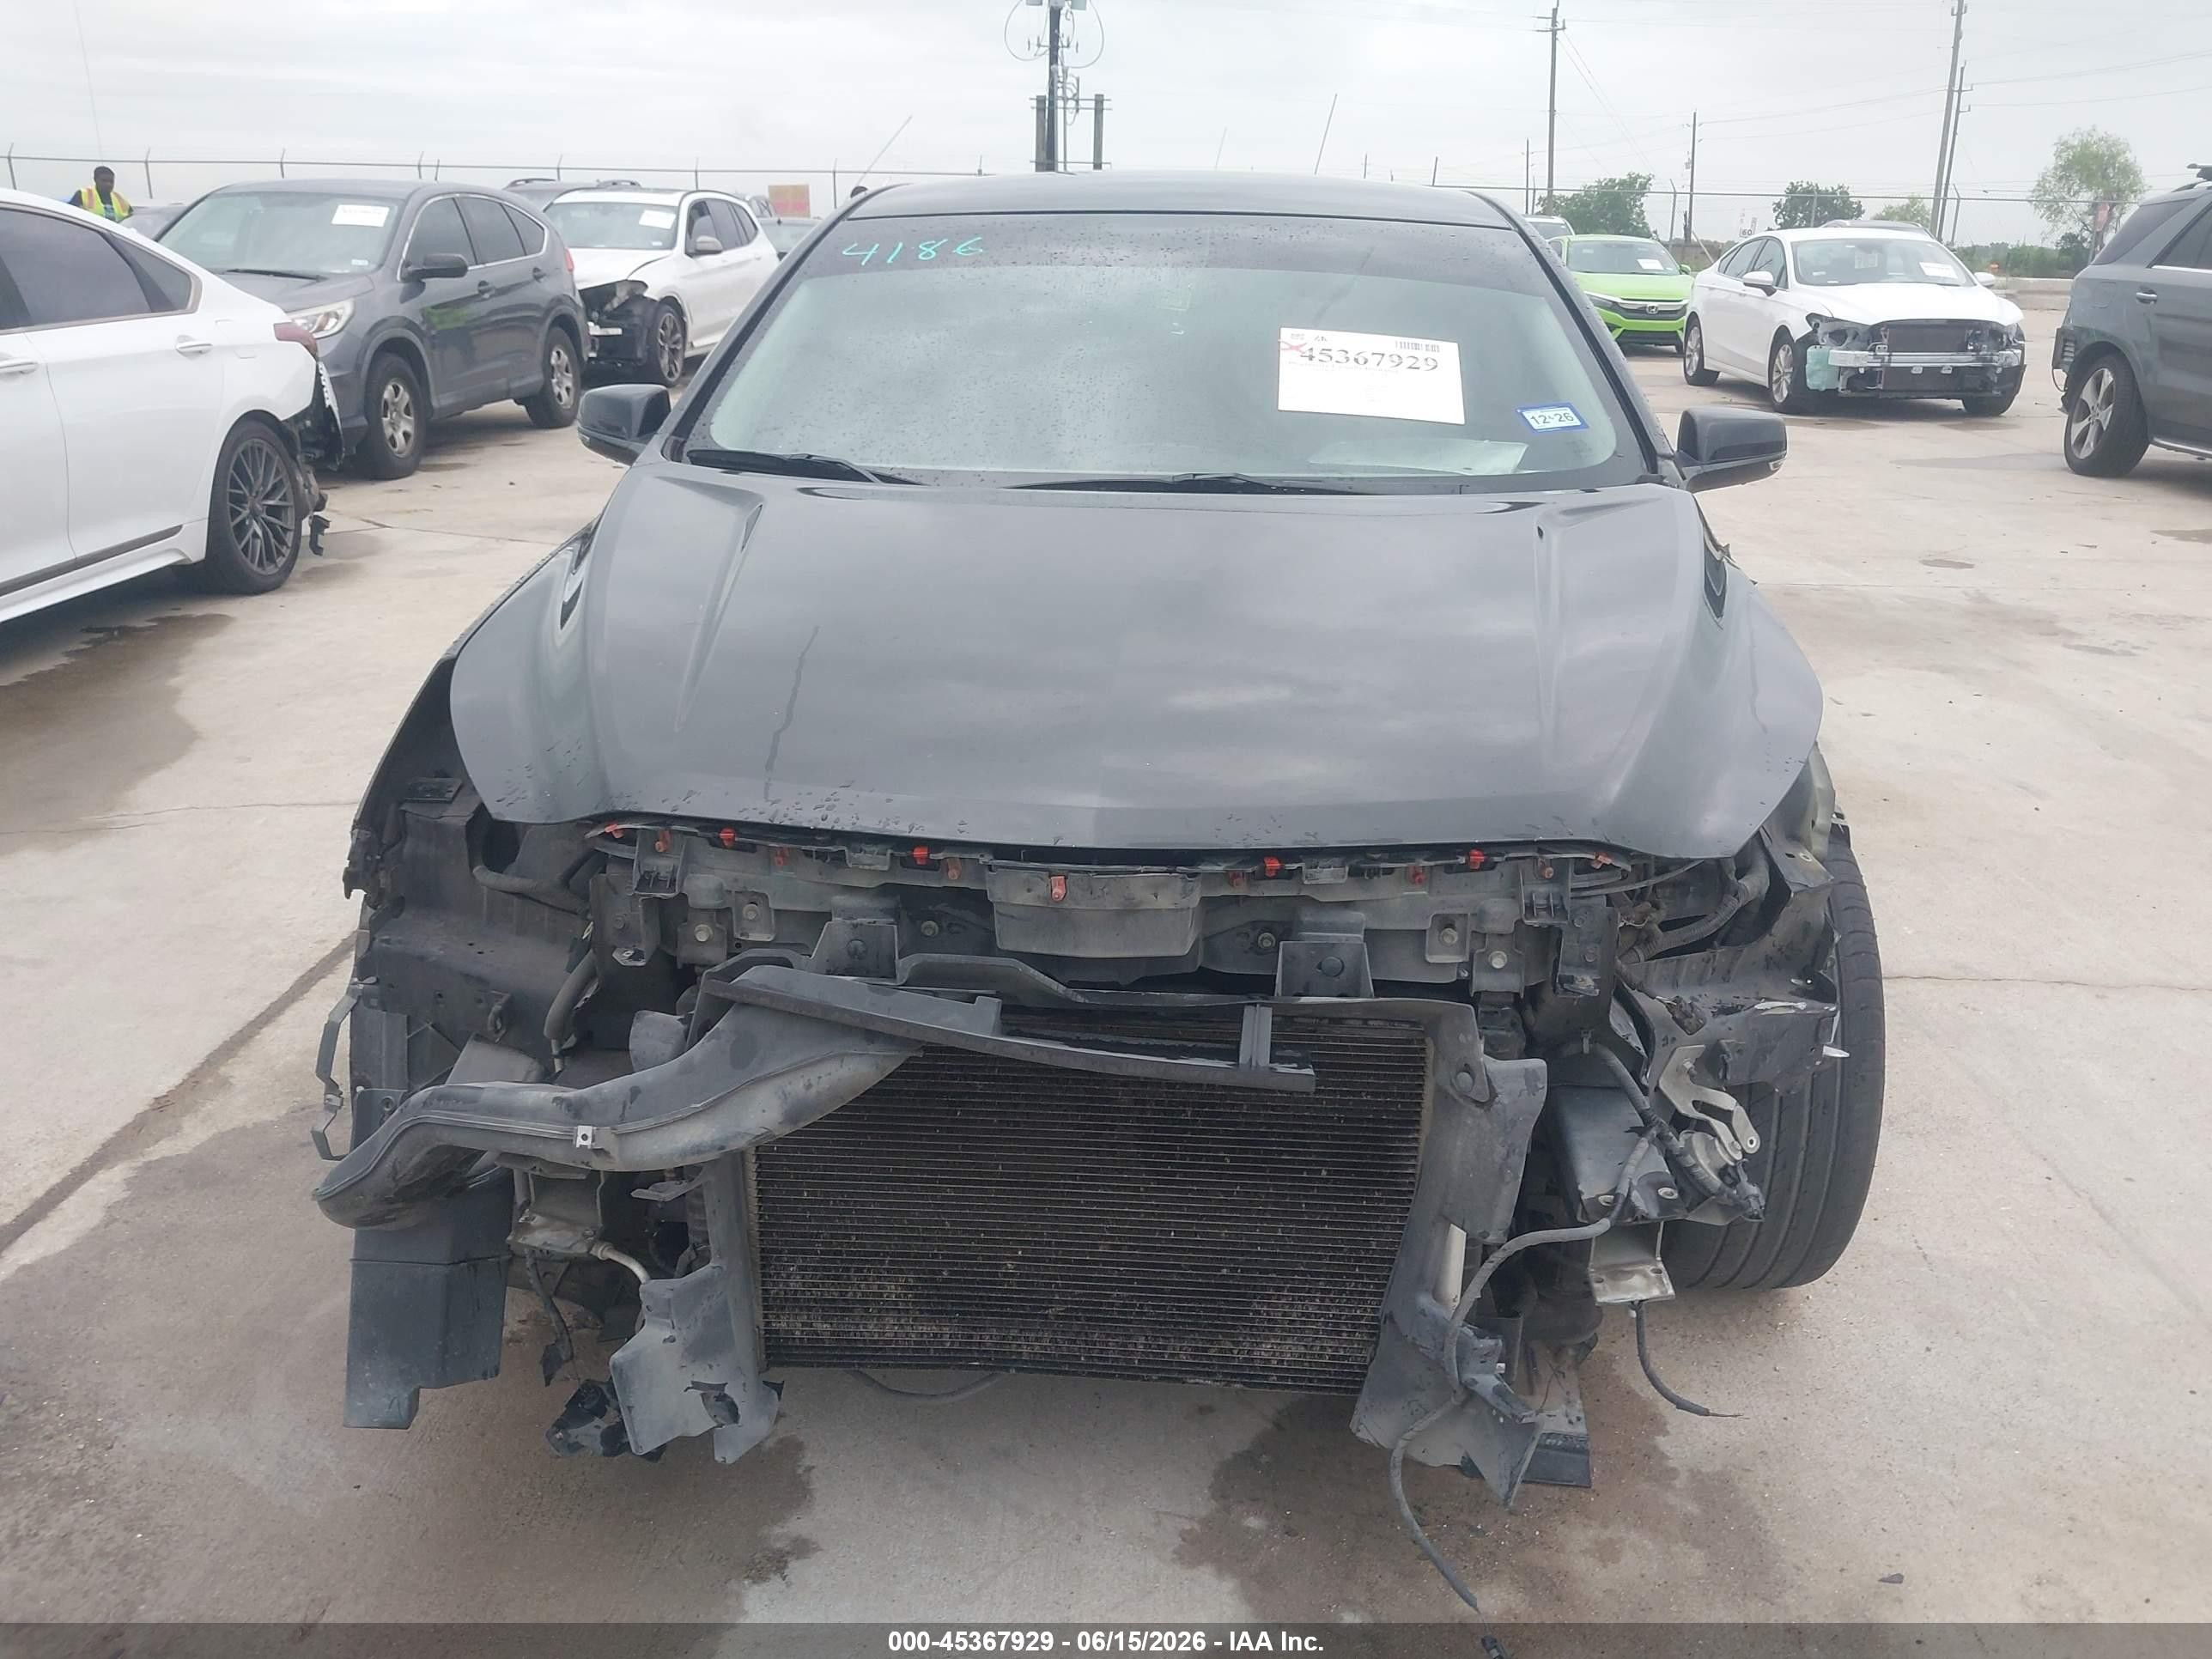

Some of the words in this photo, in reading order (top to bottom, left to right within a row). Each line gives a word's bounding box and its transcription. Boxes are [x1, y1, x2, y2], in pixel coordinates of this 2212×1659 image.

[1299, 347, 1439, 371] 45367929
[1530, 415, 1551, 424] 12
[1553, 412, 1574, 422] 26
